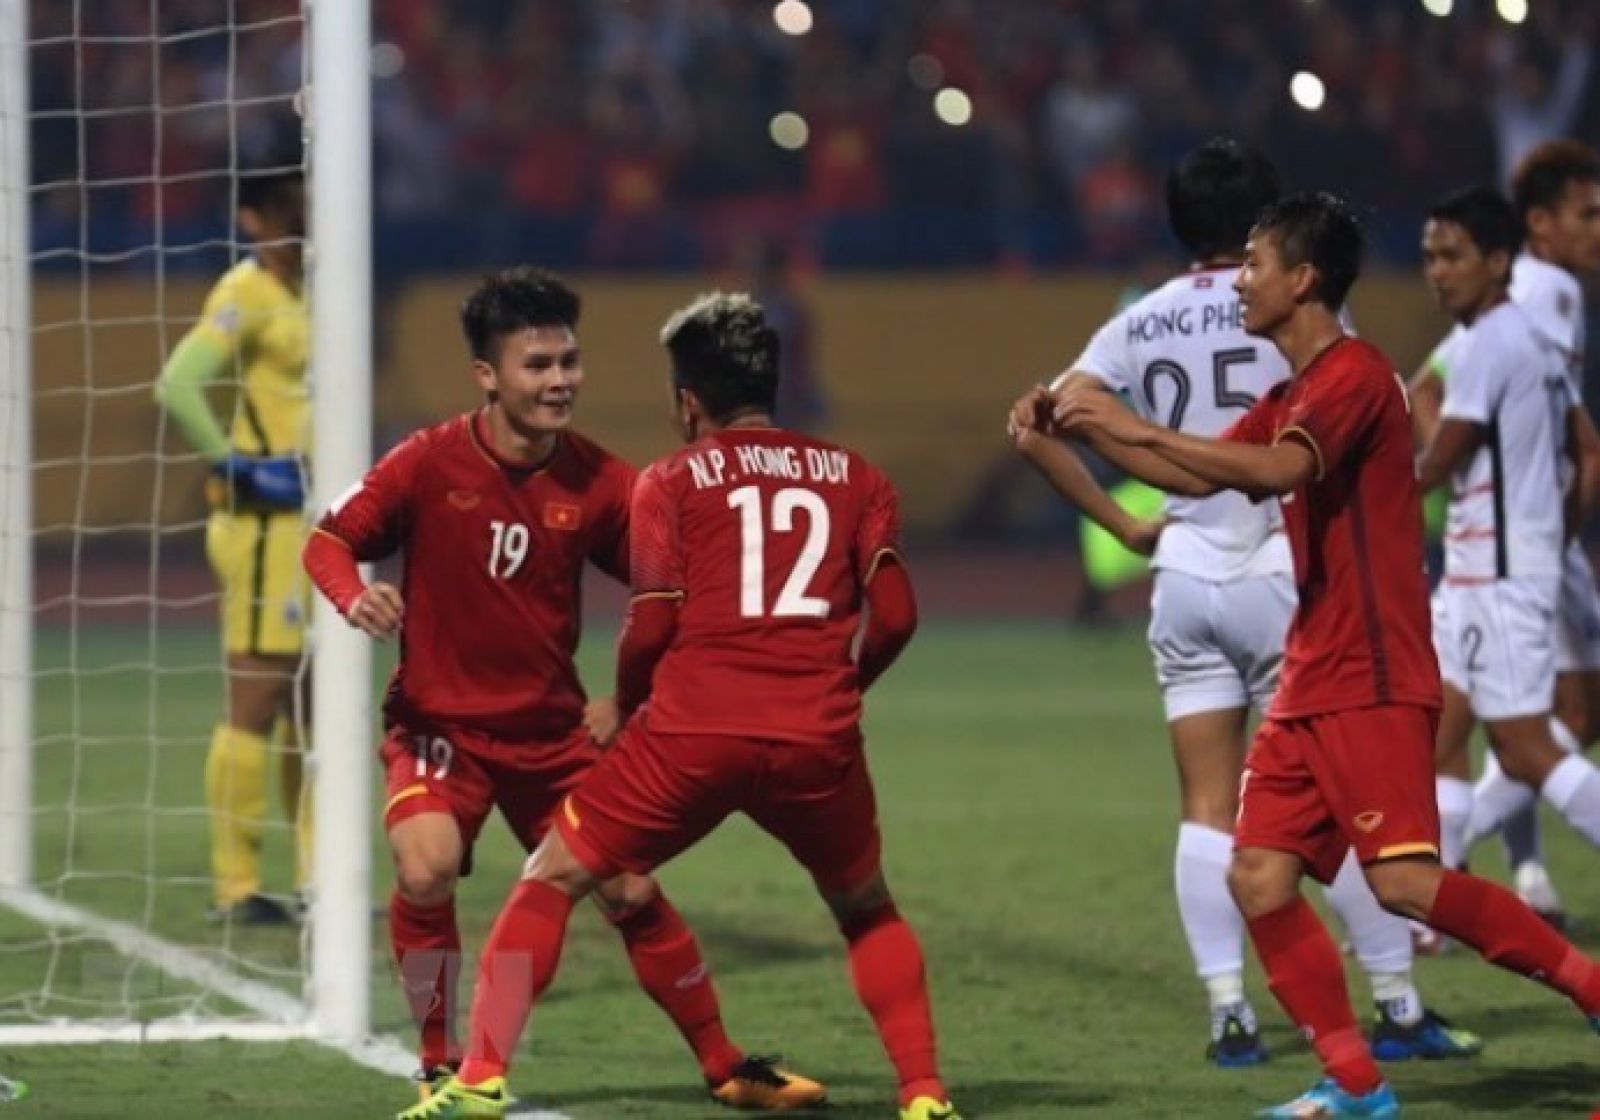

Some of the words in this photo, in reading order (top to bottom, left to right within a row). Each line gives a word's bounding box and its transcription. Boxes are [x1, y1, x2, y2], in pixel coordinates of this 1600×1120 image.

[1126, 307, 1193, 344] HONG
[1202, 301, 1245, 333] PHE
[489, 520, 529, 578] 19
[727, 485, 832, 617] 12
[1461, 623, 1487, 672] 2
[414, 735, 452, 780] 19
